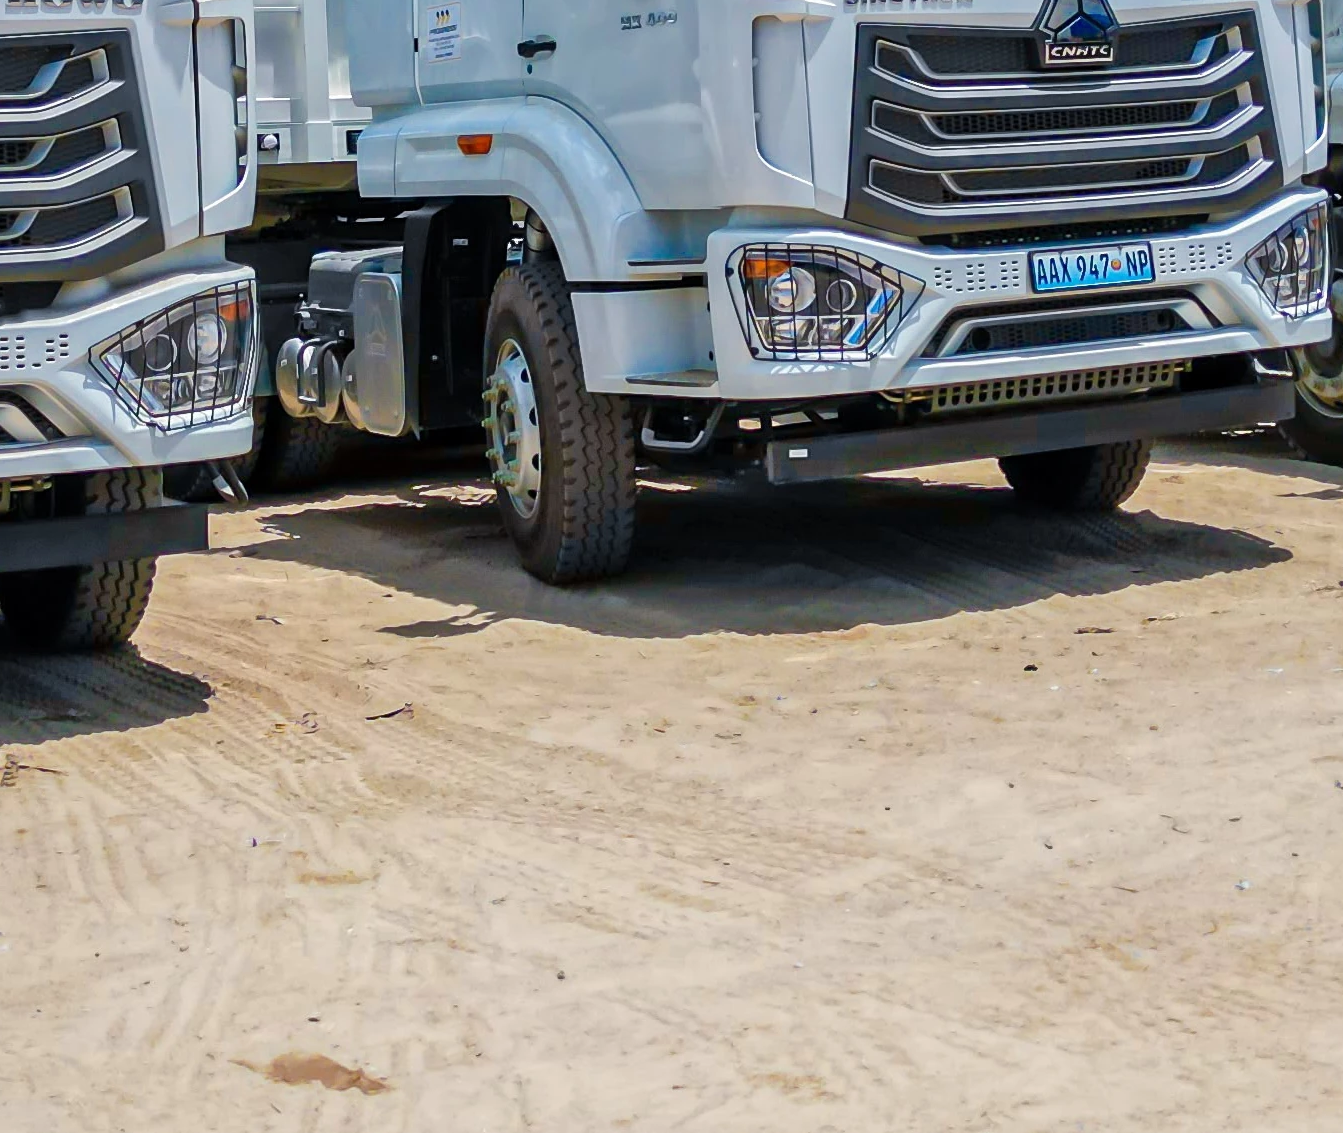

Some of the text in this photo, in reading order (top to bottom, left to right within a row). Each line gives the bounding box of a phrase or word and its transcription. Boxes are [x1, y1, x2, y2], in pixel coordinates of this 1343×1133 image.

[1050, 45, 1109, 57] CNHTC
[1037, 249, 1149, 285] AAX 947 NP
